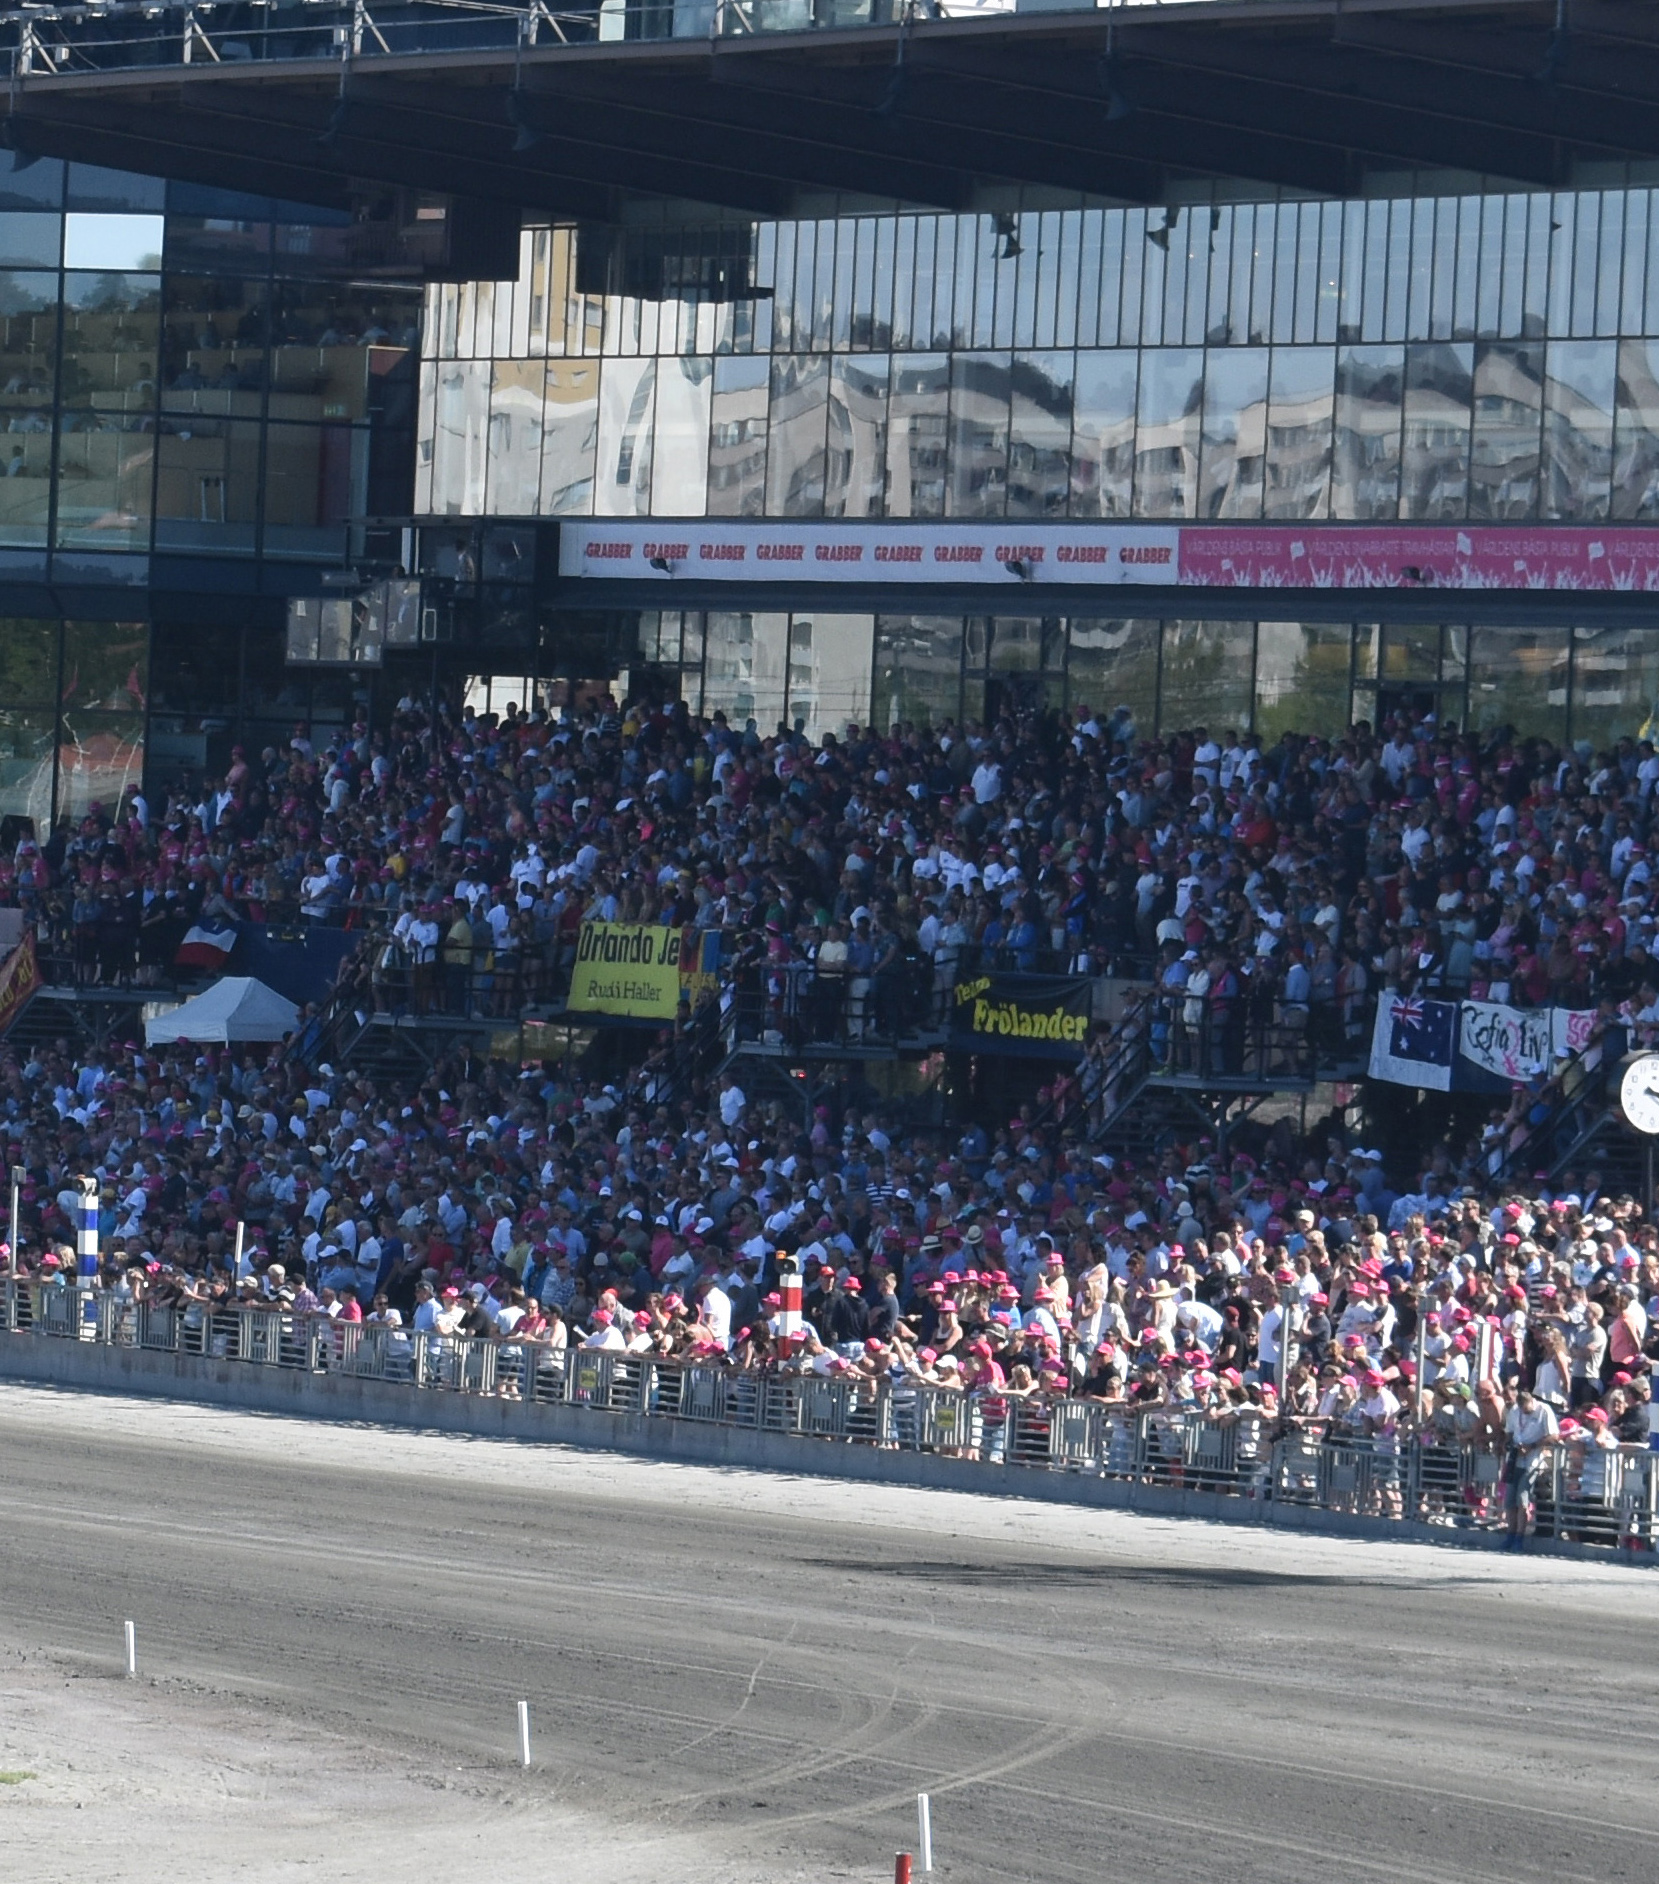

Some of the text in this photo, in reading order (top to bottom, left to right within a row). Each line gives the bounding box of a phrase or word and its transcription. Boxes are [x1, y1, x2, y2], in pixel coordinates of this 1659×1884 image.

[586, 542, 1172, 564] GRABBER GRABBER GRABBER GRABBER GRABBER GRABBER GRABBER GRABBER GRABBER GRABBER
[578, 924, 653, 964] Orlando
[588, 980, 620, 999] Rudi
[623, 981, 662, 1001] Haller
[973, 998, 1088, 1041] Frölander
